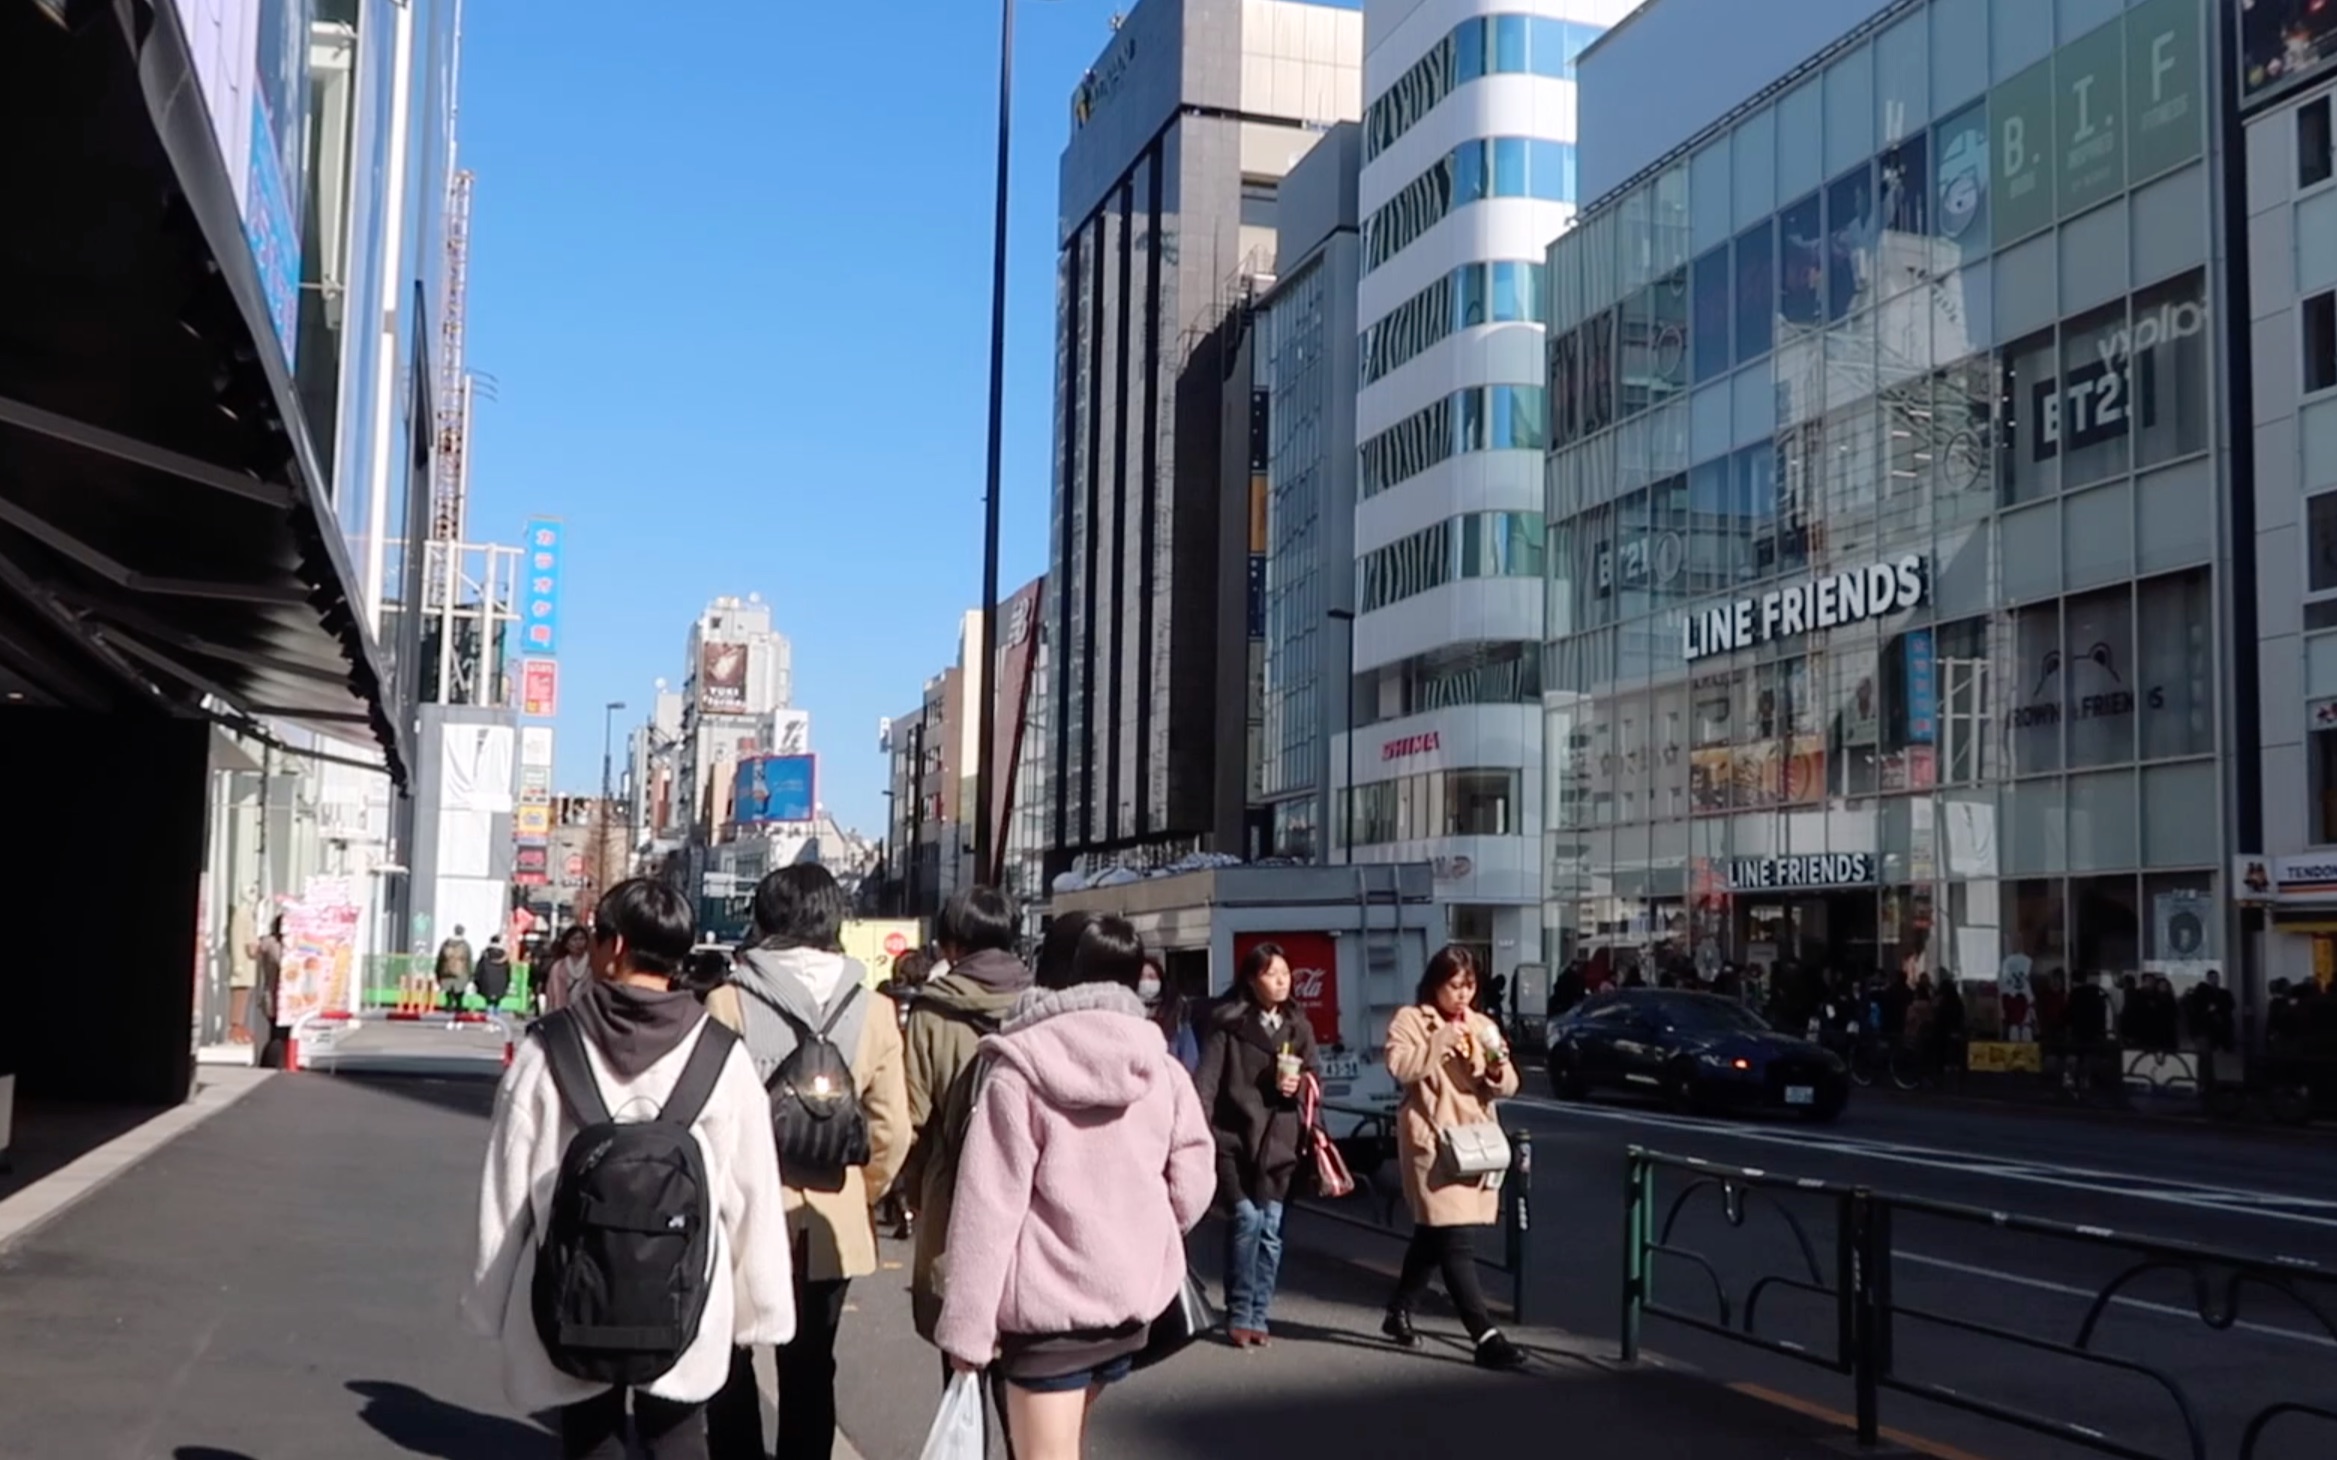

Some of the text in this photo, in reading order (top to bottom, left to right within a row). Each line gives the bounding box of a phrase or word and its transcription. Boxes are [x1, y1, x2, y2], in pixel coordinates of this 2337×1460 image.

[2152, 29, 2176, 102] F
[1600, 538, 1649, 588] B21
[1682, 554, 1922, 660] LINE FRIENDS
[2081, 685, 2165, 720] FRIENS
[1381, 730, 1441, 762] SHIMA
[1728, 852, 1867, 889] LINE FRIENDS
